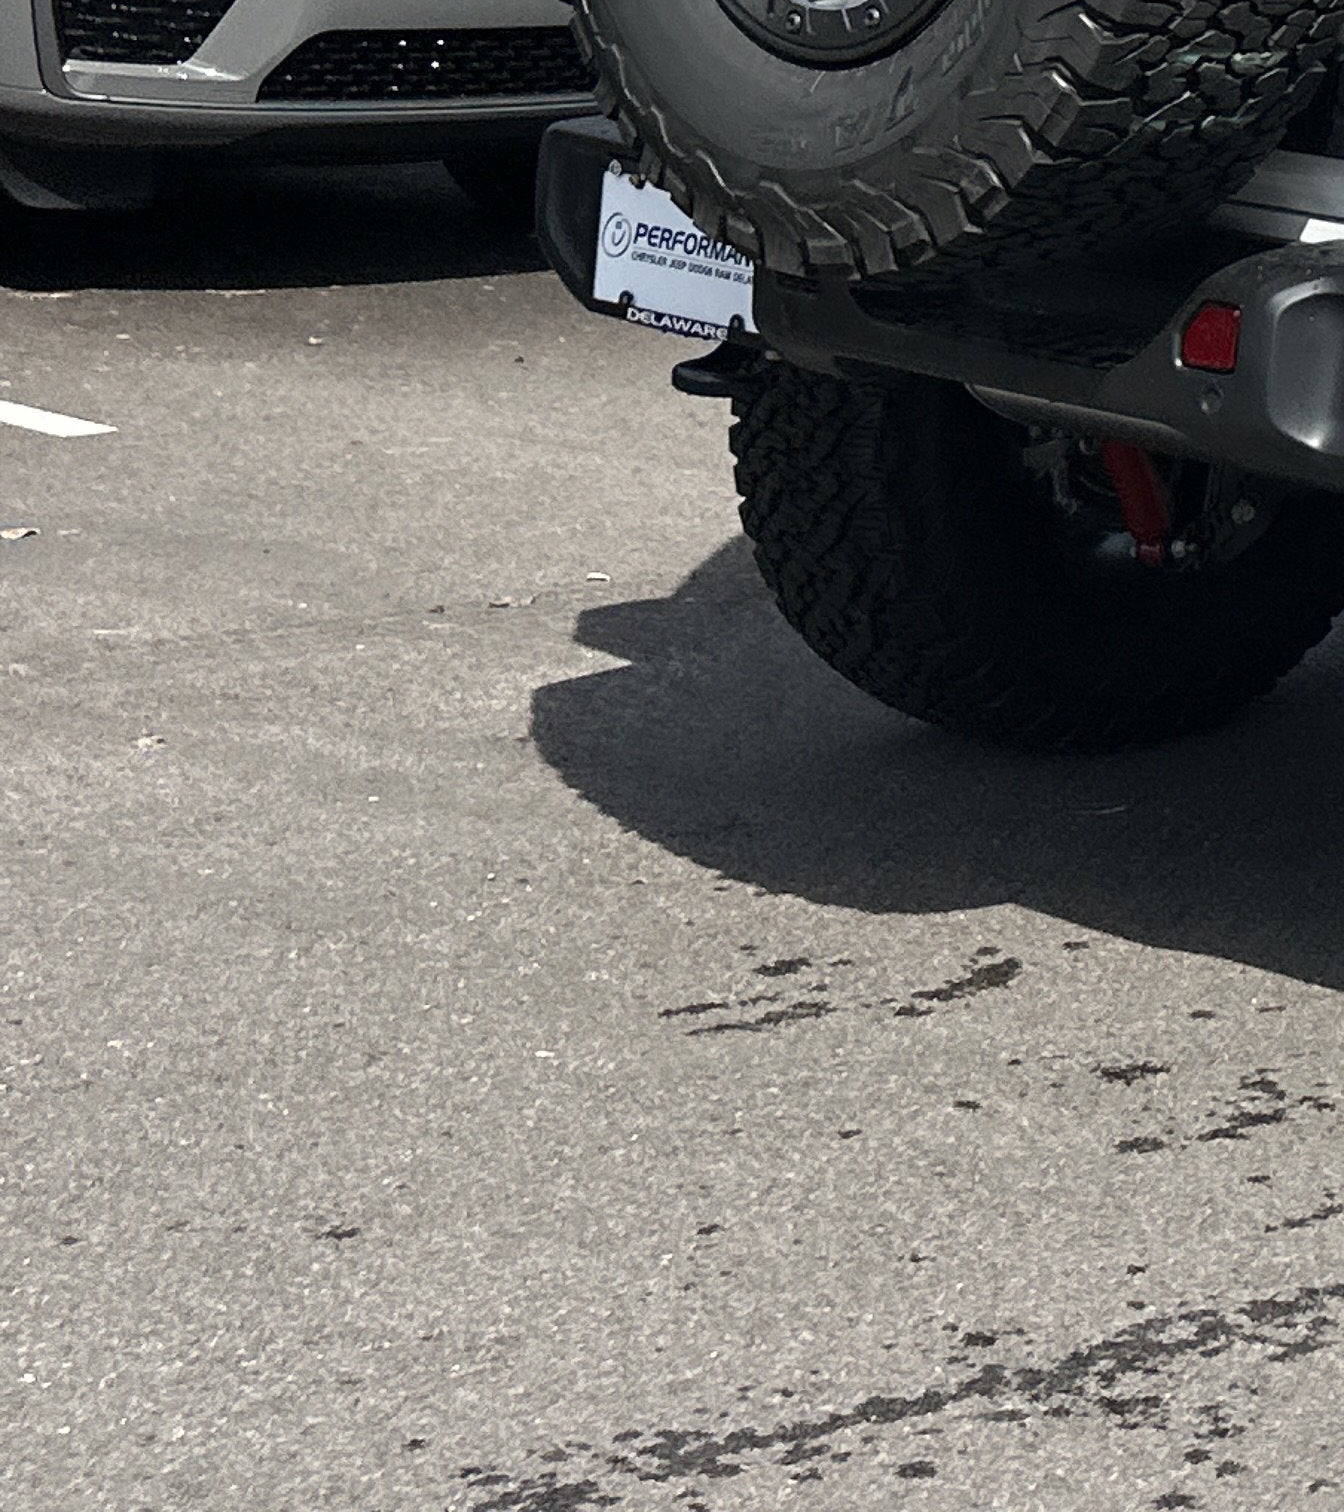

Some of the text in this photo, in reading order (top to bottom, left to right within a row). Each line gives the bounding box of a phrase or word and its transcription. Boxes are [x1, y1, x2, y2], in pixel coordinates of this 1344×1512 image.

[631, 251, 668, 267] CHRYSLER
[669, 258, 688, 270] JEEP
[688, 261, 713, 277] DODGE
[626, 307, 728, 339] DELAWARE
